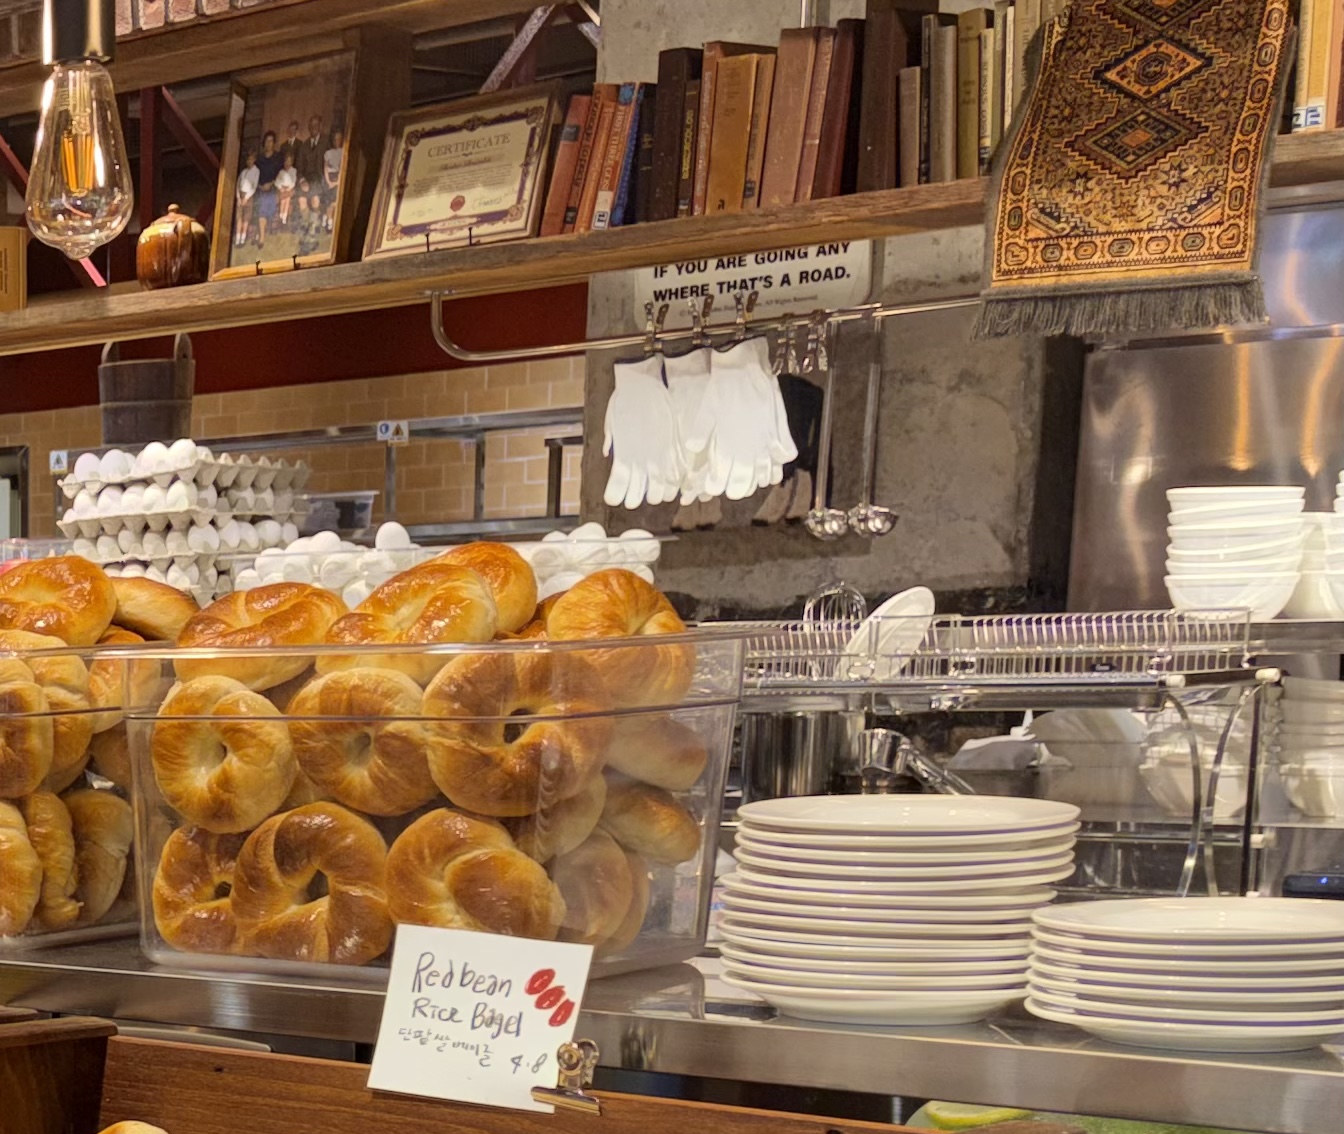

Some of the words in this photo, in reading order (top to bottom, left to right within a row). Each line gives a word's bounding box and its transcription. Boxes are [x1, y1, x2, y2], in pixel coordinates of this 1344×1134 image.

[427, 133, 511, 158] CERTIFICATE
[675, 260, 708, 276] YOU
[715, 254, 747, 270] ARE
[816, 242, 850, 257] ANY
[653, 284, 710, 303] WHERE
[717, 275, 773, 295] THAT'S
[780, 274, 792, 288] A
[799, 266, 851, 285] ROAD.
[412, 997, 463, 1023] Rice
[470, 1001, 524, 1040] Bagel
[510, 1052, 548, 1074] 4.8
